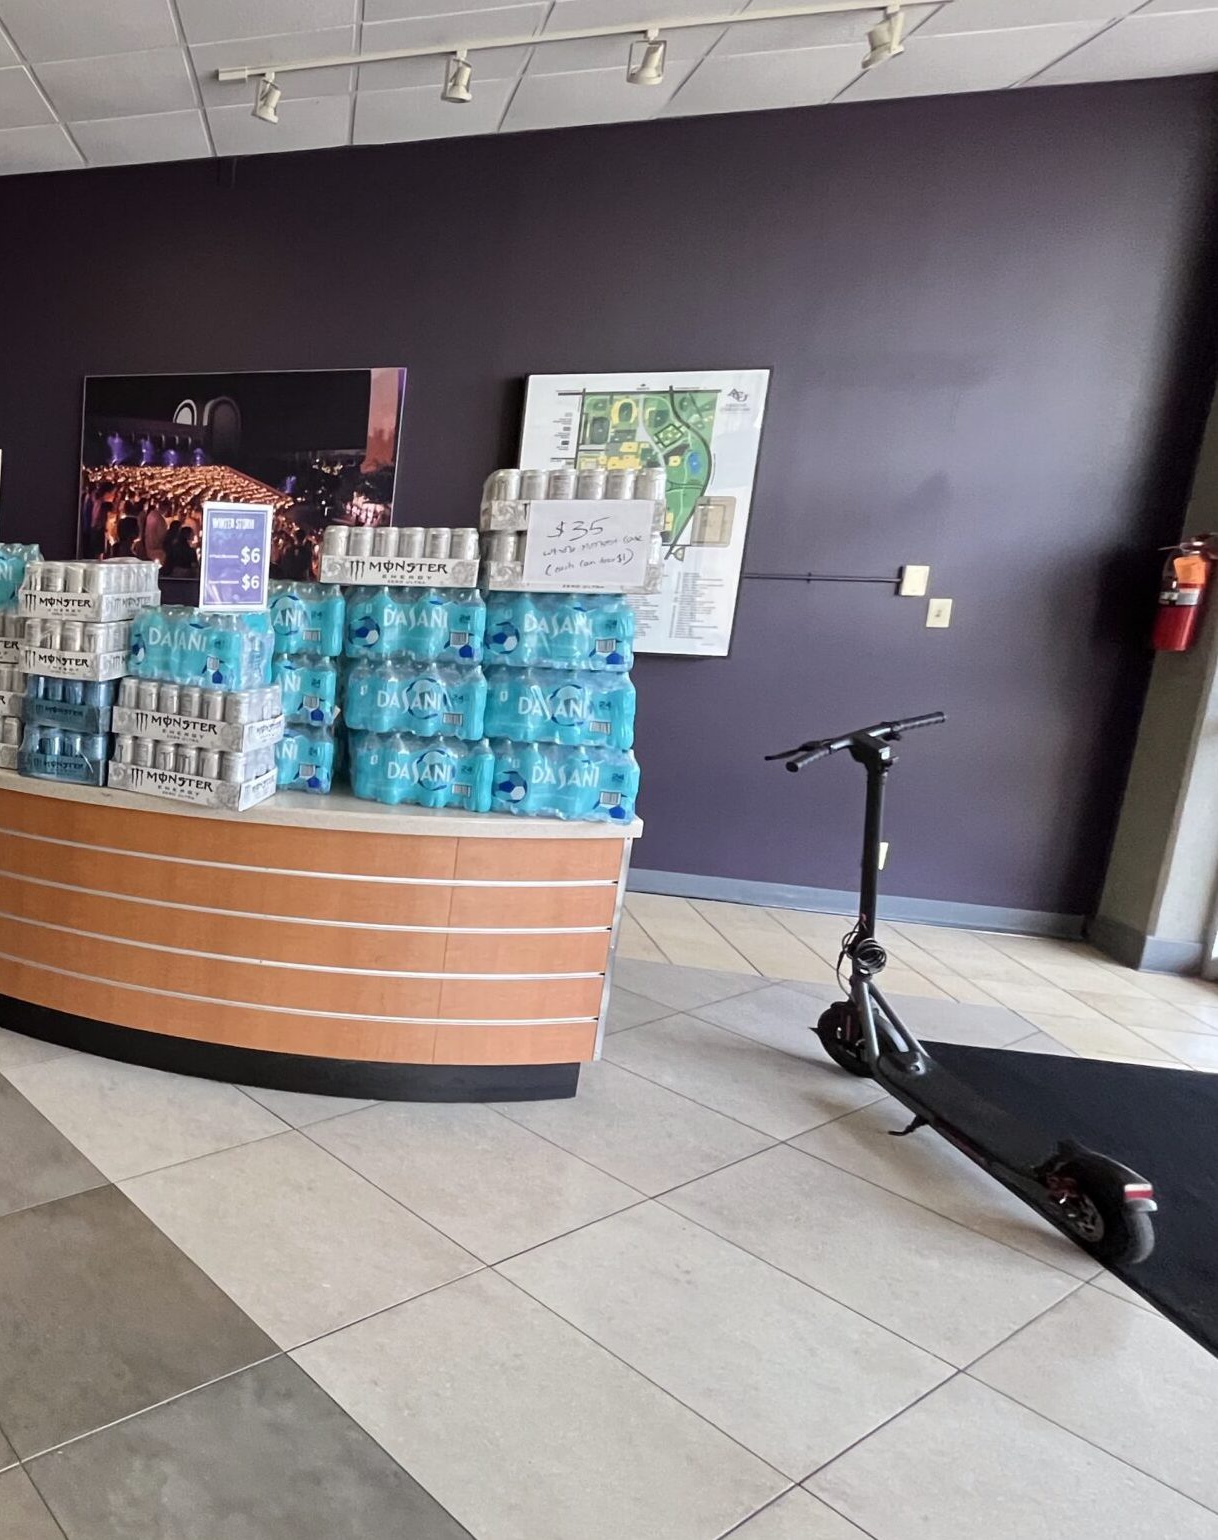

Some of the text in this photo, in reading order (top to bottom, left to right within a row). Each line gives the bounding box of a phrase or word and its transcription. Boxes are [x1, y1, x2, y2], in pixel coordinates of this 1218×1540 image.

[546, 516, 612, 542] $35
[240, 545, 261, 565] $6
[368, 560, 448, 575] MONSTER
[241, 573, 260, 592] $6
[39, 596, 92, 608] MONSTER
[383, 606, 448, 631] DASANI
[523, 609, 593, 639] DASANI
[148, 626, 208, 653] DASANI
[38, 654, 90, 668] MONSTER
[377, 687, 442, 714] DASANI
[151, 714, 218, 735] MONSTER
[146, 771, 214, 793] MONSTER
[387, 760, 452, 786] DASANI
[531, 762, 600, 790] DASANI
